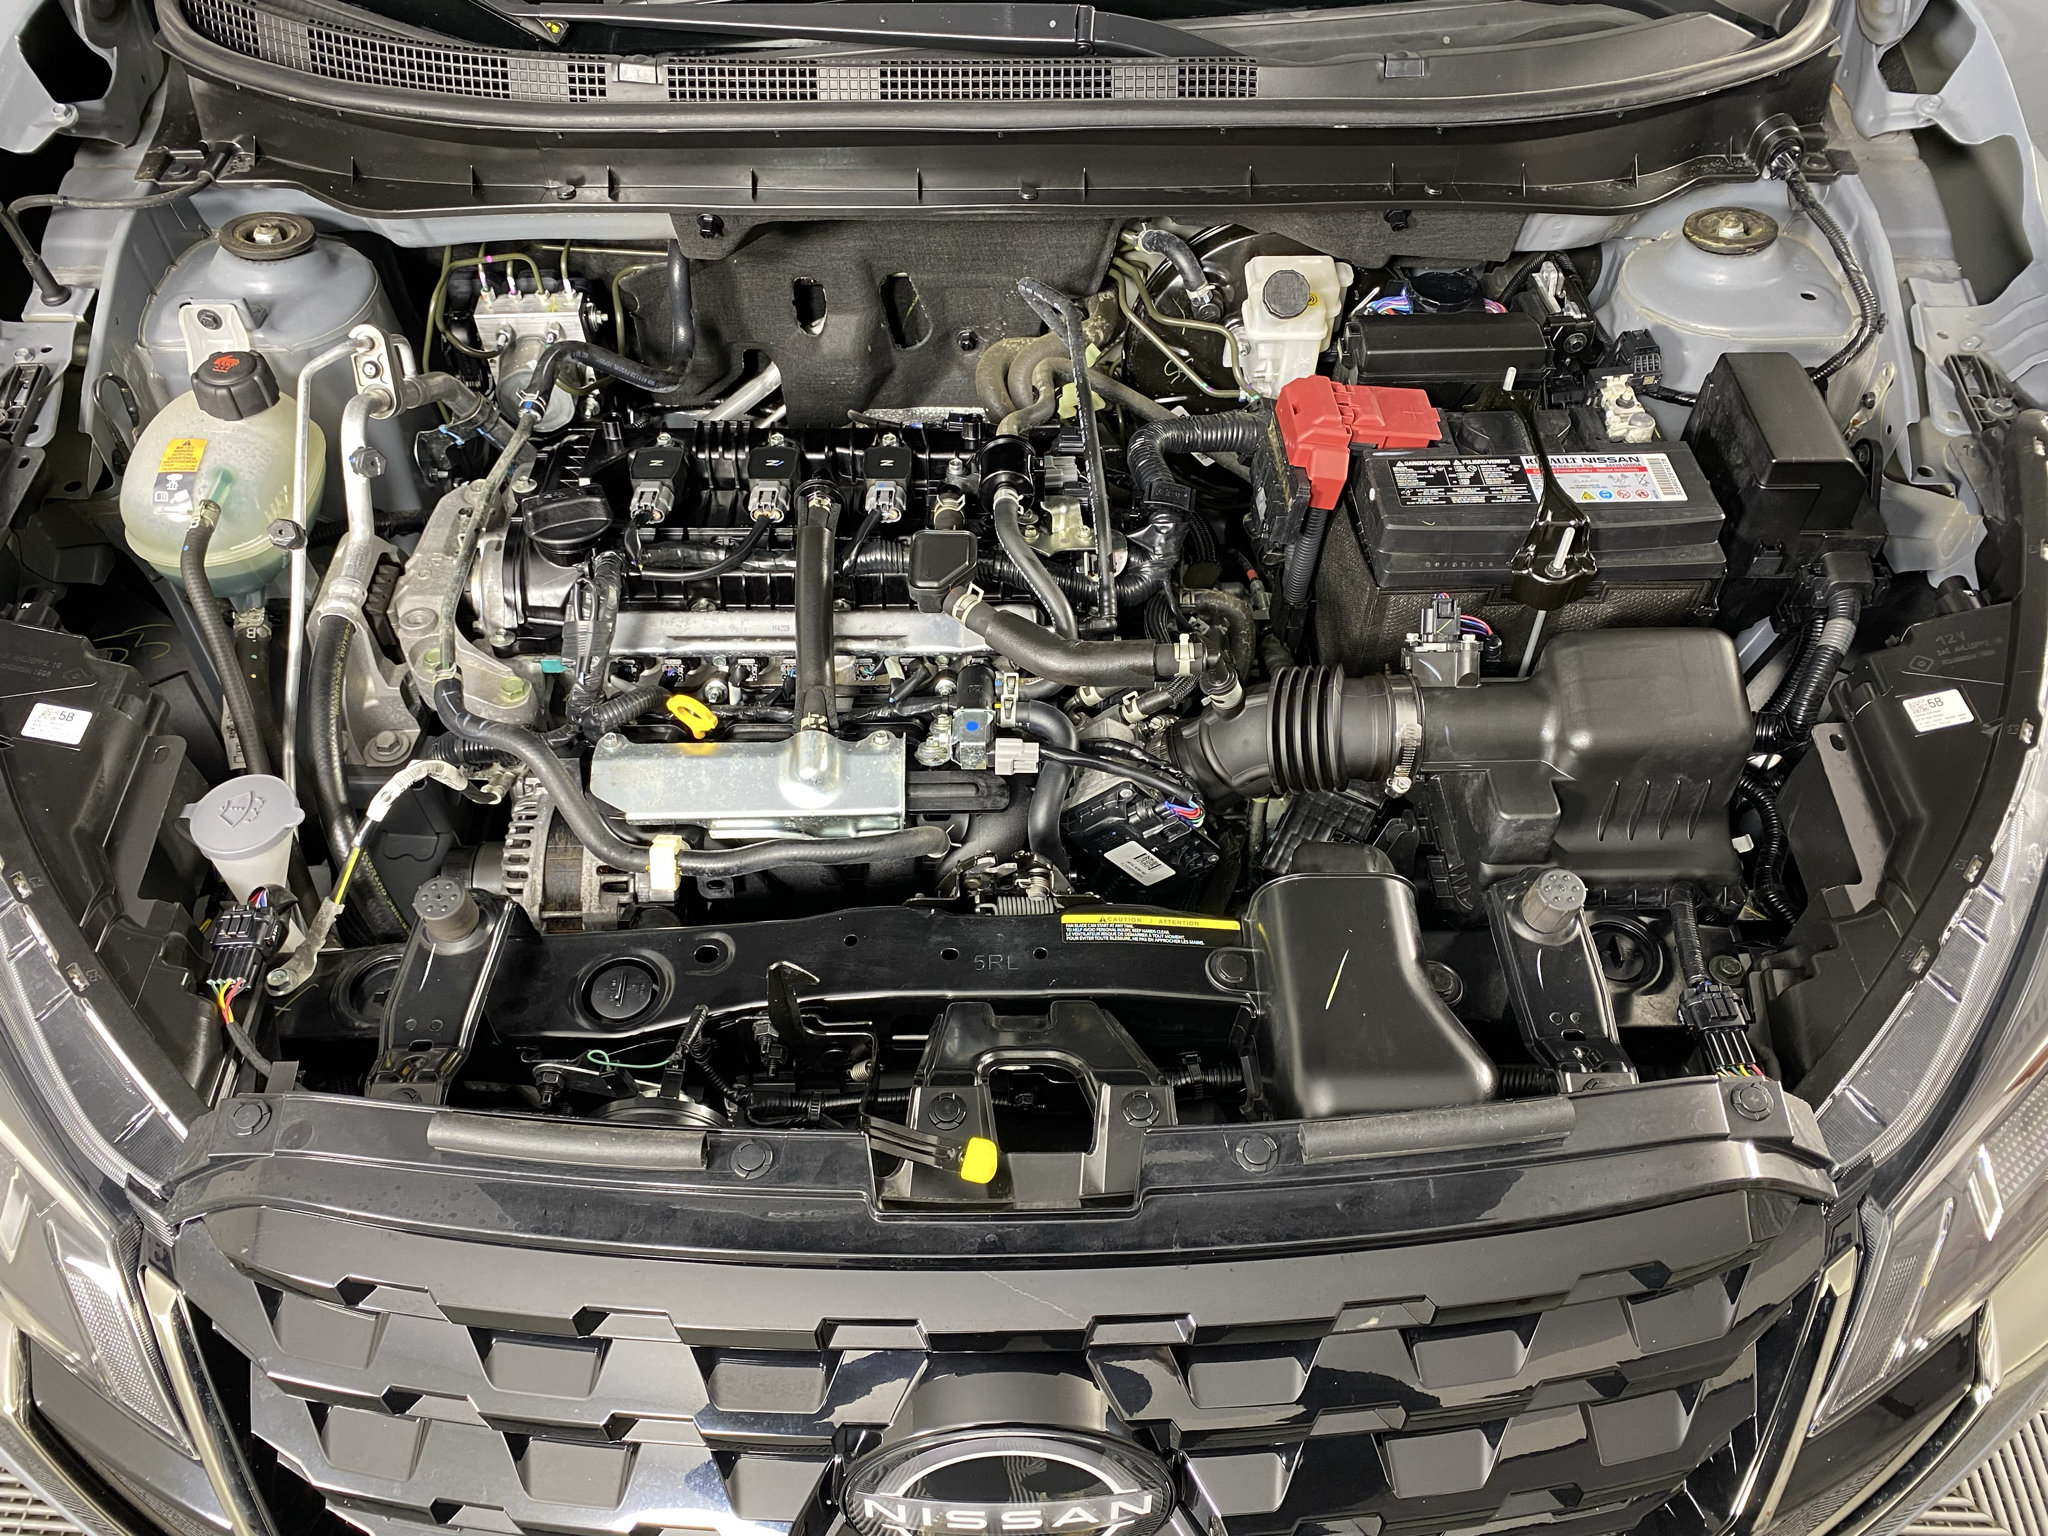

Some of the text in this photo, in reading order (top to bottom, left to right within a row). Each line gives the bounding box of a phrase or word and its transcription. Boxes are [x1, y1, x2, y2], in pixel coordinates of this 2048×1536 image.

[1926, 697, 1944, 708] 5B
[58, 711, 75, 722] 5B
[974, 954, 1019, 970] 5RL
[864, 1494, 1152, 1530] NISSAN
